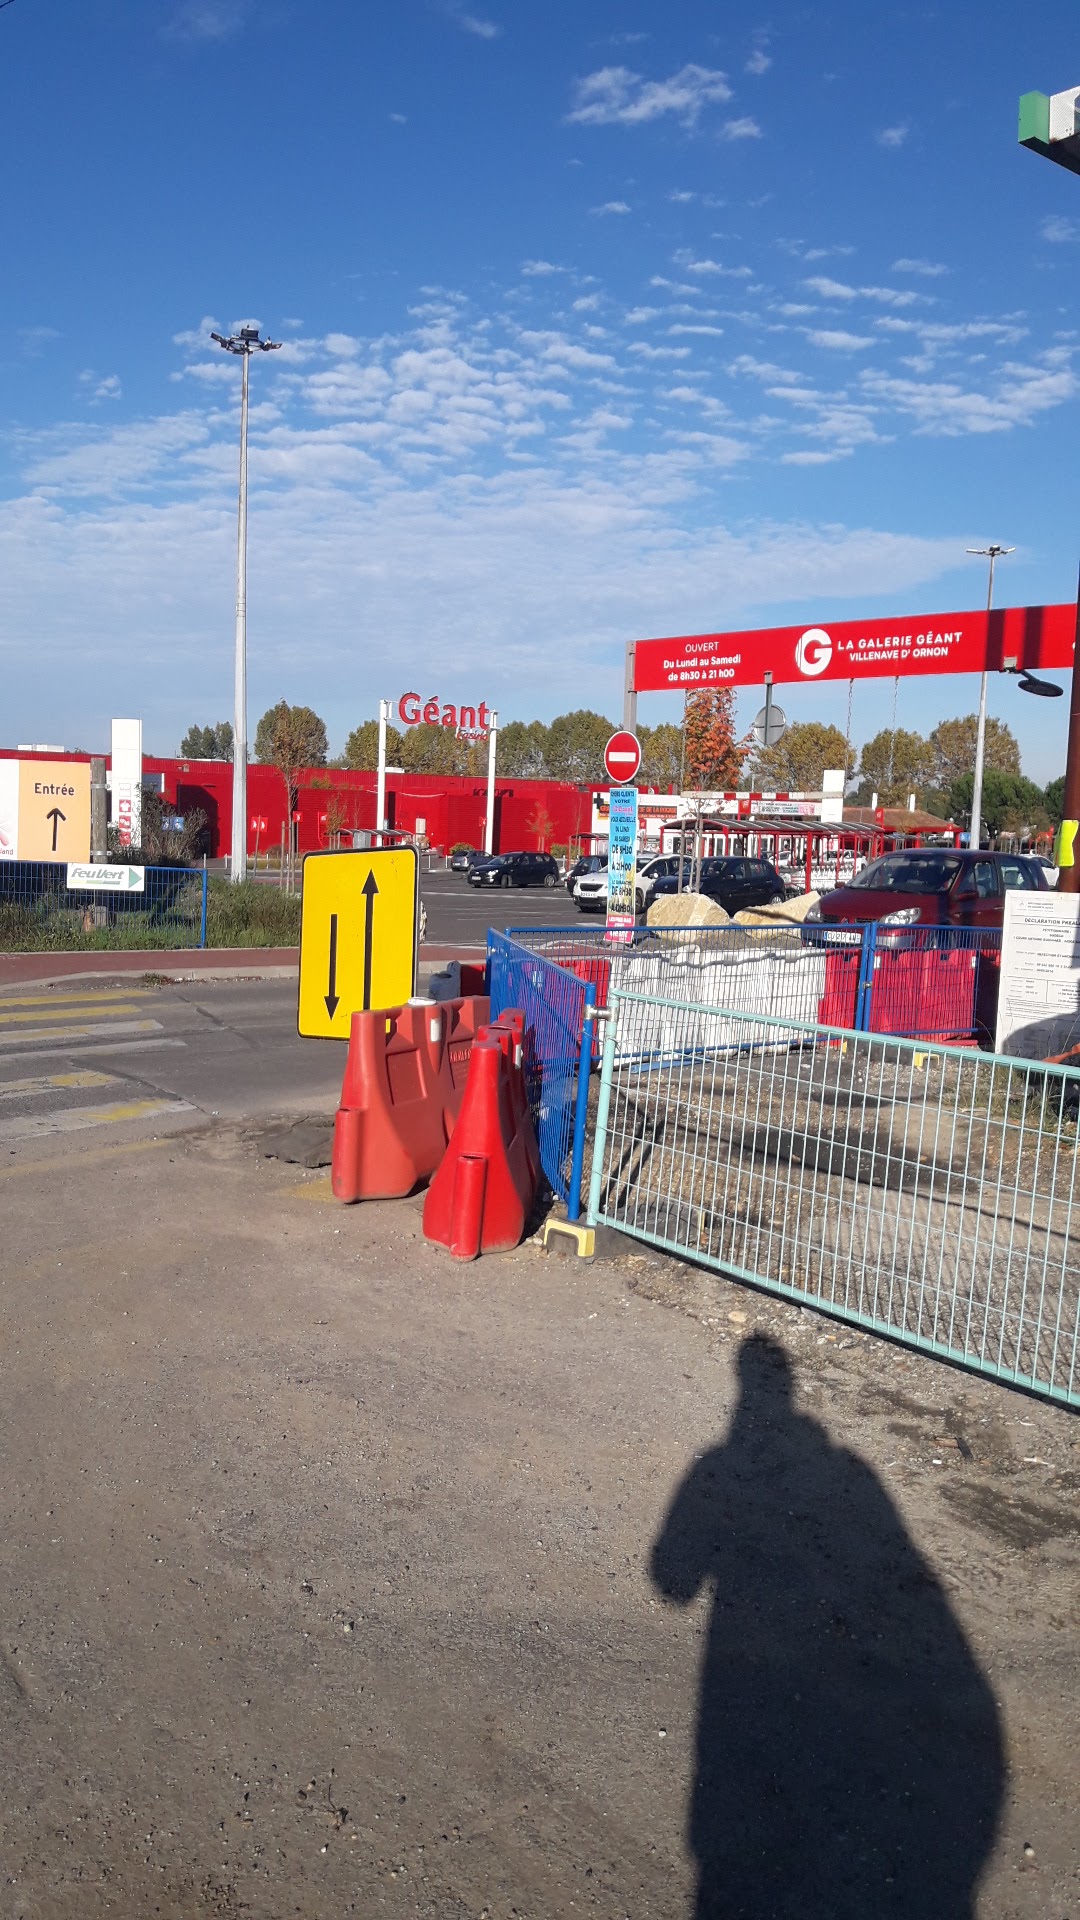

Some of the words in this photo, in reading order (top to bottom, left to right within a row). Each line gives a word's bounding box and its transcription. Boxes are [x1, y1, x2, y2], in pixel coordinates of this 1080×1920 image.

[685, 641, 720, 653] OUVERT
[838, 638, 854, 650] LA
[858, 635, 912, 649] GALERIE
[916, 631, 963, 645] GÉANT
[849, 648, 899, 662] VILLENAVE
[912, 646, 949, 657] ORNON
[663, 659, 675, 669] Du
[676, 657, 698, 668] Lundi
[699, 658, 710, 667] au
[711, 653, 741, 666] Samedi
[668, 672, 679, 682] de
[680, 670, 700, 681] 8h30
[701, 669, 707, 680] à
[398, 691, 490, 731] Géant
[34, 782, 75, 796] Entrée
[0, 848, 14, 856] and
[612, 844, 619, 854] DE
[612, 885, 618, 896] DE
